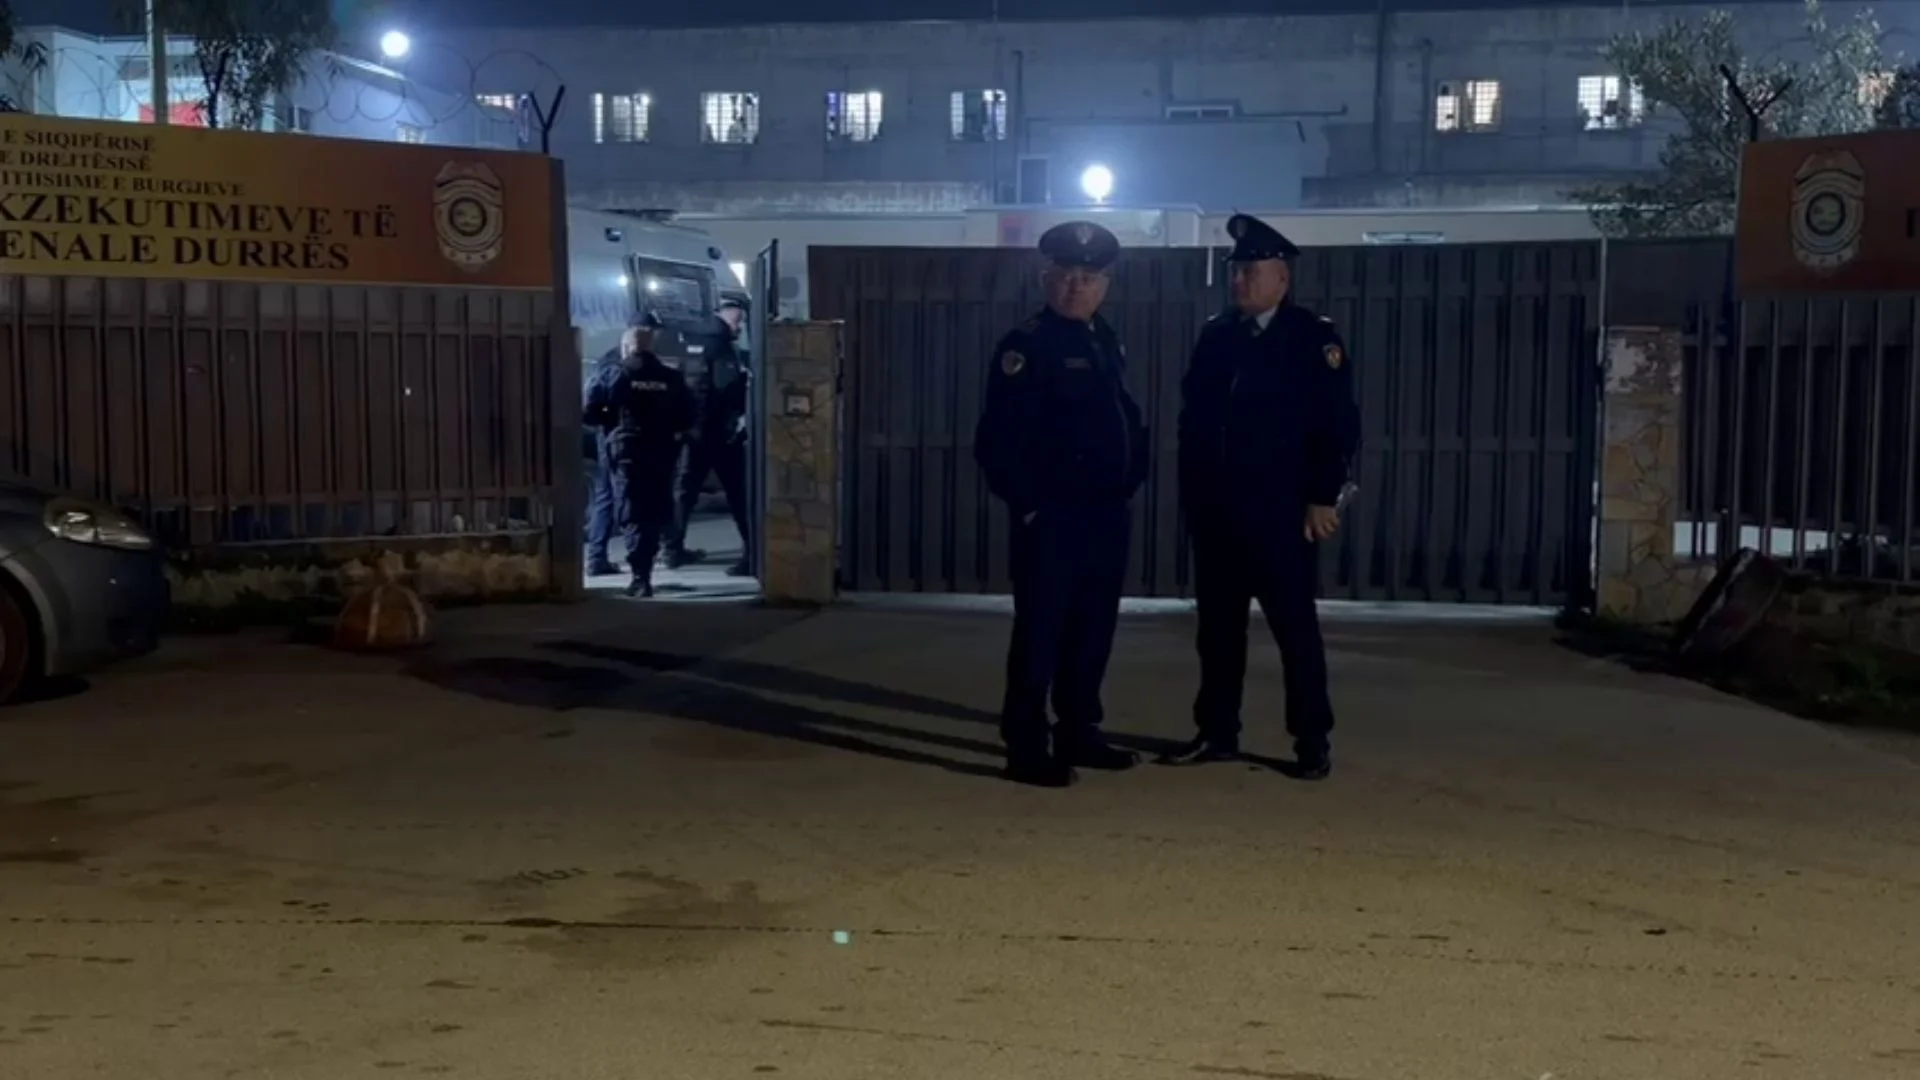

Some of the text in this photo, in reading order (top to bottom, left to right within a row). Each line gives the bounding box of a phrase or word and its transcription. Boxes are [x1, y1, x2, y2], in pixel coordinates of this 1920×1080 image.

[5, 129, 155, 152] E SHQIPËRISË
[0, 150, 152, 171] E DREJTËSISË
[113, 177, 126, 191] E
[133, 177, 246, 196] BURGJEVE
[344, 204, 398, 238] TË
[0, 229, 350, 270] ENALE DURRËS
